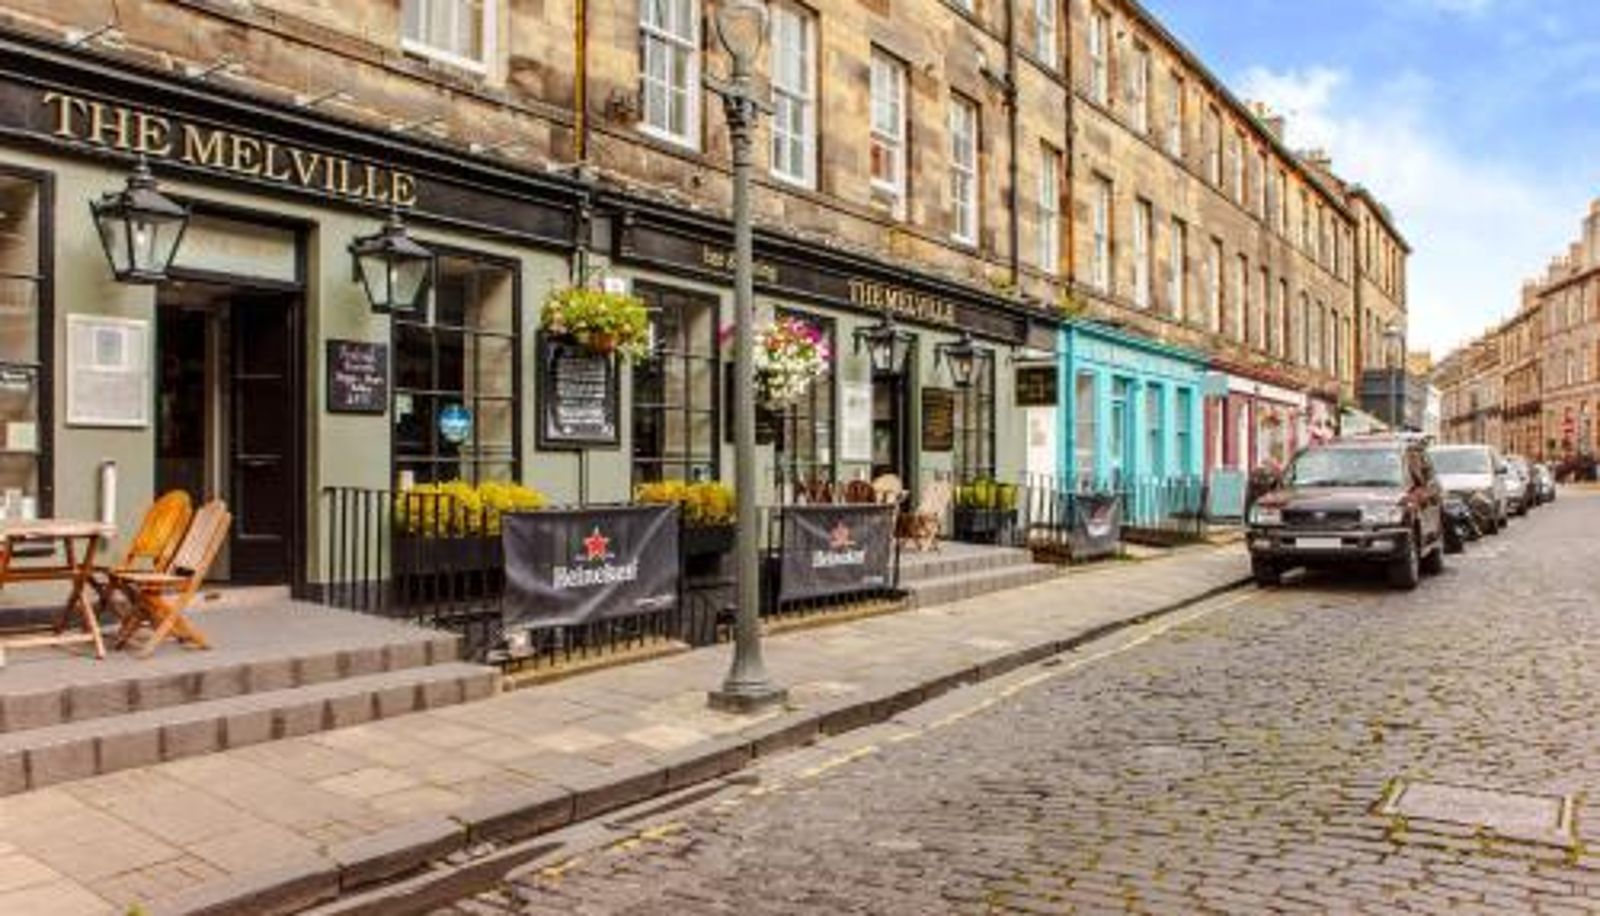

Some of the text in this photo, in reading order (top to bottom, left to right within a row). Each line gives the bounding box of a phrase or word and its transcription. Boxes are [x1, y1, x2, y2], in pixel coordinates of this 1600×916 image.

[44, 93, 417, 207] THE MELVILLE
[848, 278, 954, 322] THE MELVILLE
[552, 560, 638, 590] Heineken
